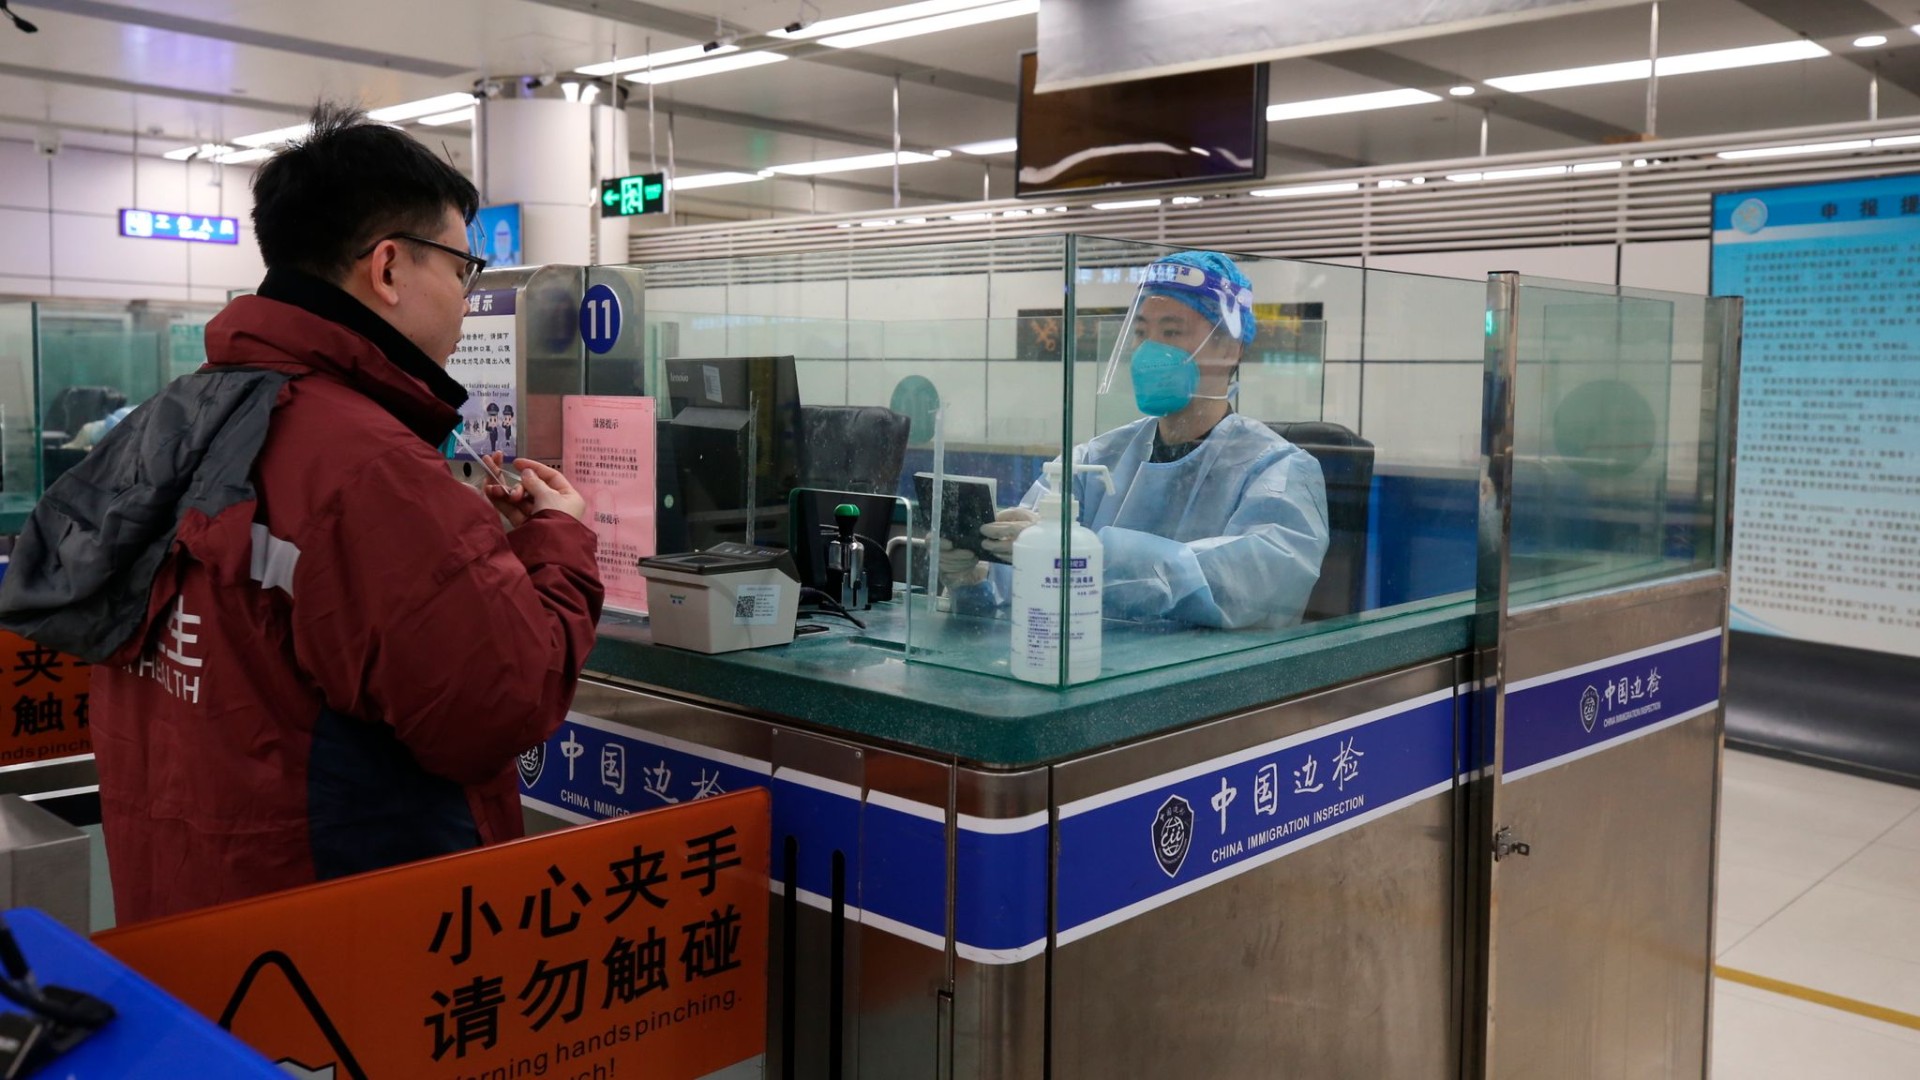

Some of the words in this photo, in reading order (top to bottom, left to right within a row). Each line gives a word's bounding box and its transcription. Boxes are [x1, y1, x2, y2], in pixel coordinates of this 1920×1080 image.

[587, 299, 611, 340] 11
[158, 594, 202, 668] 生
[138, 652, 200, 704] HEALTH
[1604, 666, 1662, 712] 中国边检
[560, 789, 590, 809] CHINA
[1211, 736, 1365, 835] 中国边检
[1211, 840, 1244, 864] CHINA
[1247, 817, 1310, 850] IMMIGRATION
[1313, 794, 1365, 825] INSPECTION
[427, 825, 742, 966] 小心夹手
[423, 904, 742, 1062] 请勿触碰
